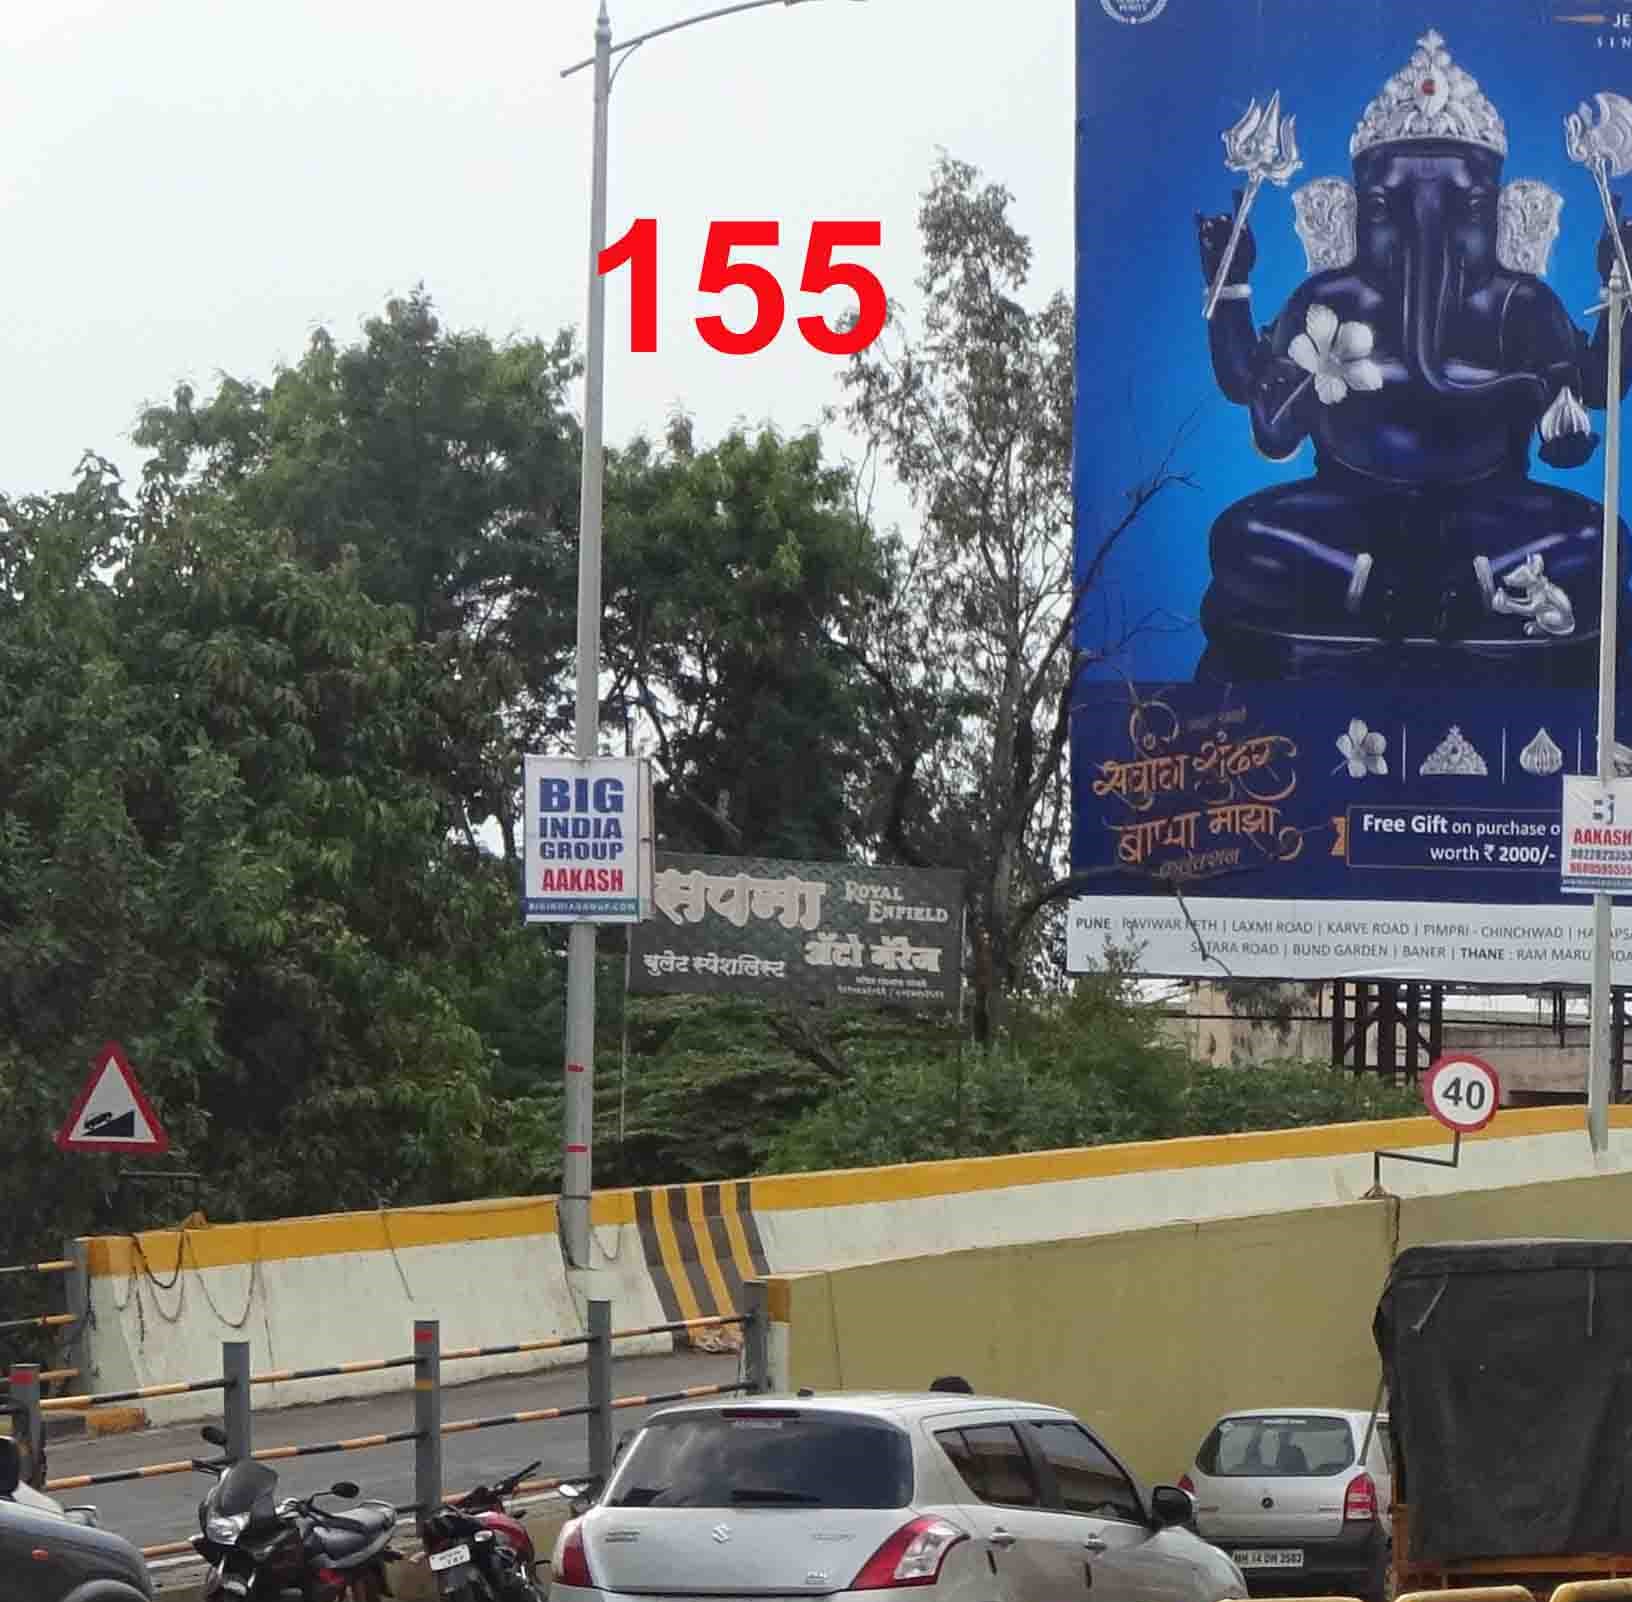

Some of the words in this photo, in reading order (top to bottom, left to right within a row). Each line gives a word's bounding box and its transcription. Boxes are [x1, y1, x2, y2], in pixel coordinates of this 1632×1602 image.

[539, 778, 624, 813] BIG
[539, 817, 623, 839] INDIA
[1363, 814, 1406, 834] Free
[1411, 815, 1448, 834] Gift
[1453, 821, 1471, 836] on
[1476, 821, 1546, 840] purchase
[1573, 828, 1632, 846] AAKASH
[539, 841, 624, 860] GROUP
[1430, 847, 1480, 864] worth
[1499, 846, 1556, 865] 2000/-
[543, 868, 624, 892] AAKASH
[845, 881, 903, 902] ROYAL
[868, 899, 949, 923] ENFIELD
[1076, 917, 1112, 931] PUNE
[1122, 916, 1181, 932] RAVIWAR
[1232, 919, 1273, 935] LAXMI
[1276, 921, 1313, 936] ROAD
[1327, 923, 1370, 937] KARVE
[1373, 924, 1412, 938] ROAD
[1424, 924, 1469, 937] PIMPRI
[1481, 926, 1563, 940] CHINCHWAD
[1242, 943, 1278, 955] ROAD
[1293, 945, 1333, 957] BUND
[1335, 945, 1388, 958] GARDEN
[1402, 946, 1452, 959] BANER
[1460, 947, 1505, 960] THANE
[1517, 949, 1548, 961] RAM
[1441, 1077, 1486, 1110] 40
